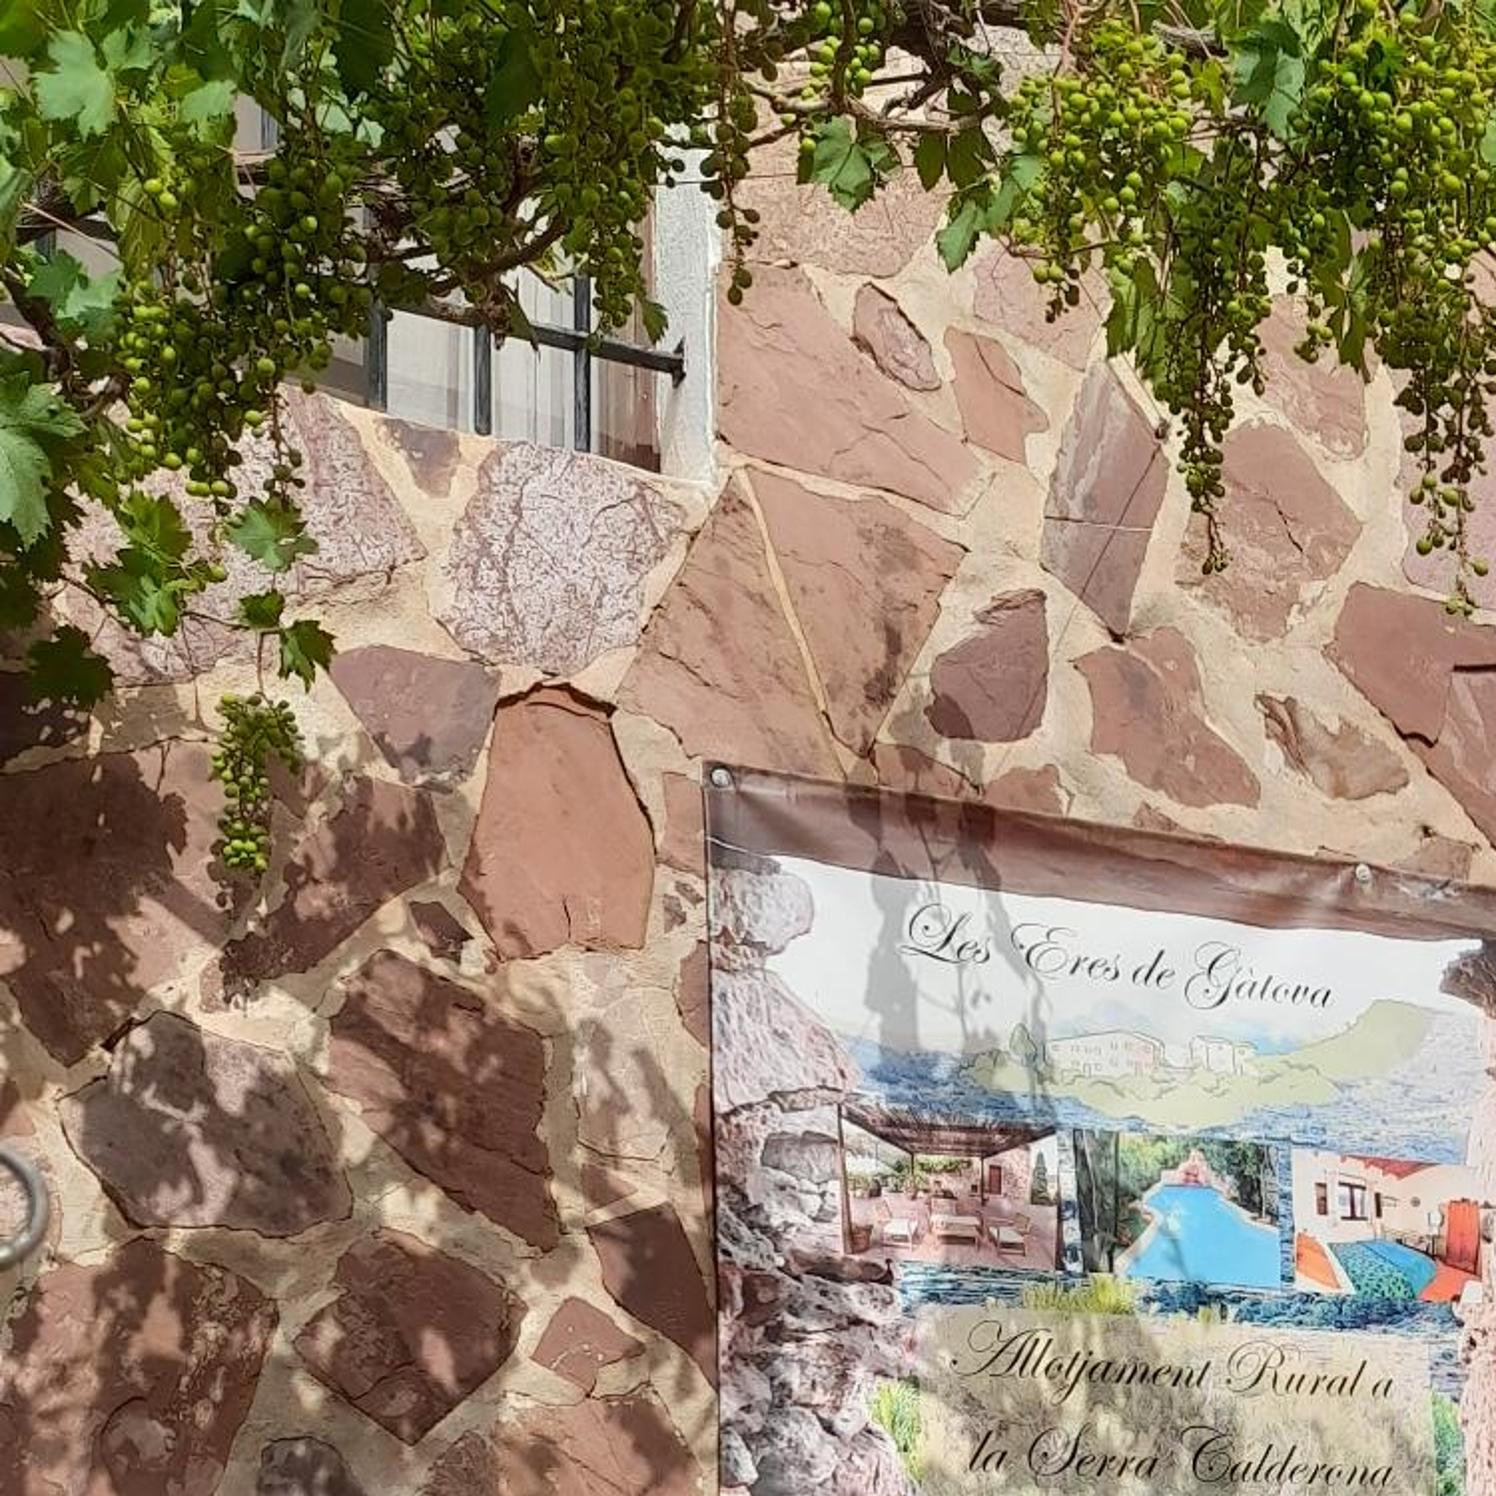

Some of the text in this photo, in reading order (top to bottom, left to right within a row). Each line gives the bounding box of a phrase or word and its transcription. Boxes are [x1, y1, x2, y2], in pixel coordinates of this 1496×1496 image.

[900, 903, 1334, 1010] Les Eres de Gàtova
[950, 1320, 1396, 1406] Allotjament Rural a
[968, 1425, 1397, 1489] la Serra Calderona
